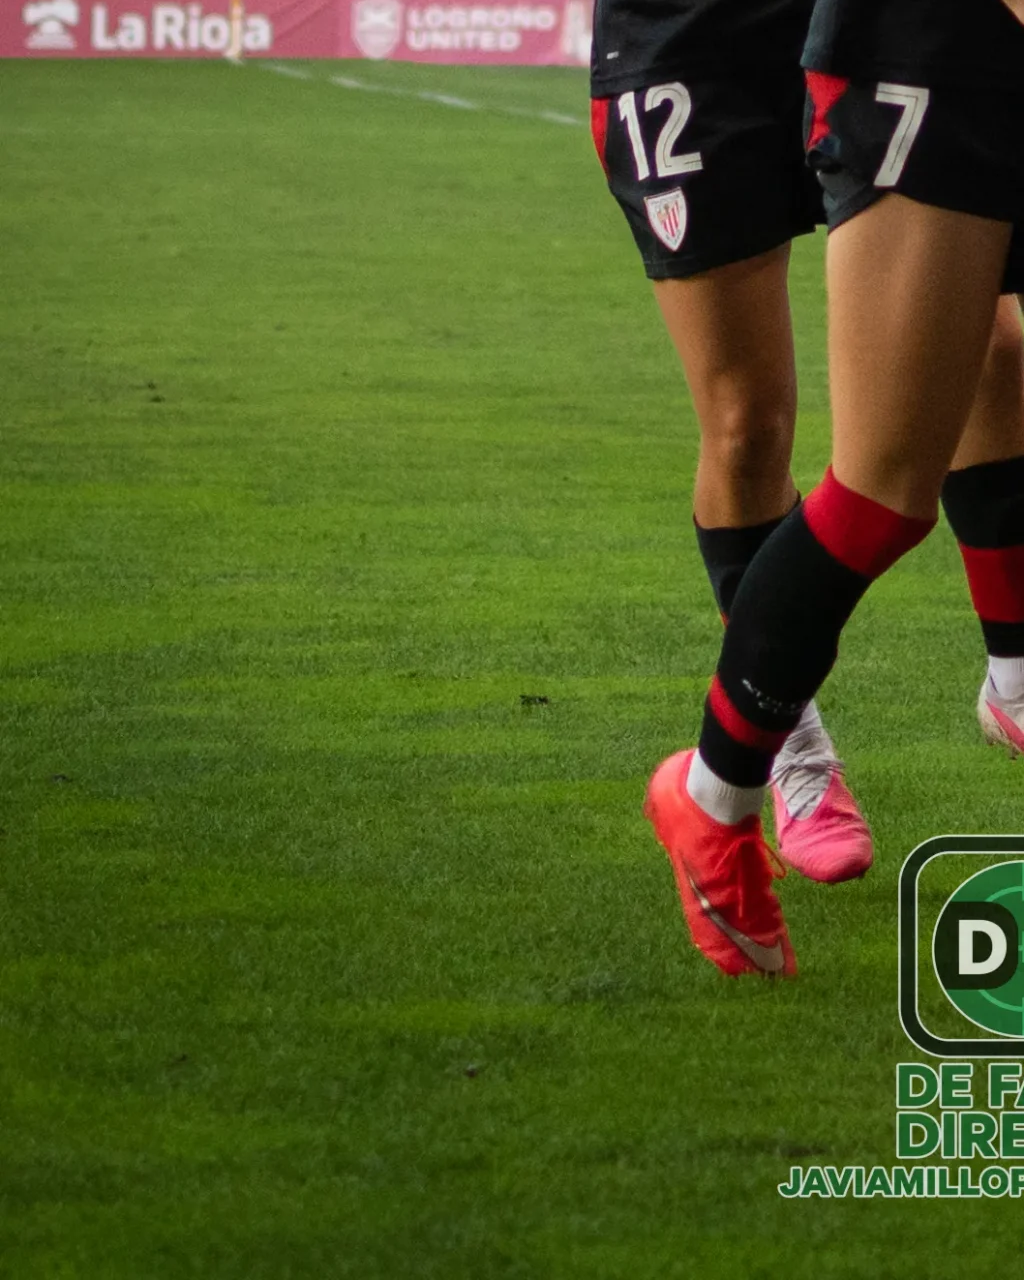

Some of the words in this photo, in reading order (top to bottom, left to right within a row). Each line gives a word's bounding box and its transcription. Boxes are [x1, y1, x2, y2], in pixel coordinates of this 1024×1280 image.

[91, 6, 146, 48] La
[407, 29, 522, 51] UNITED
[617, 81, 703, 182] 12
[873, 81, 930, 187] 7
